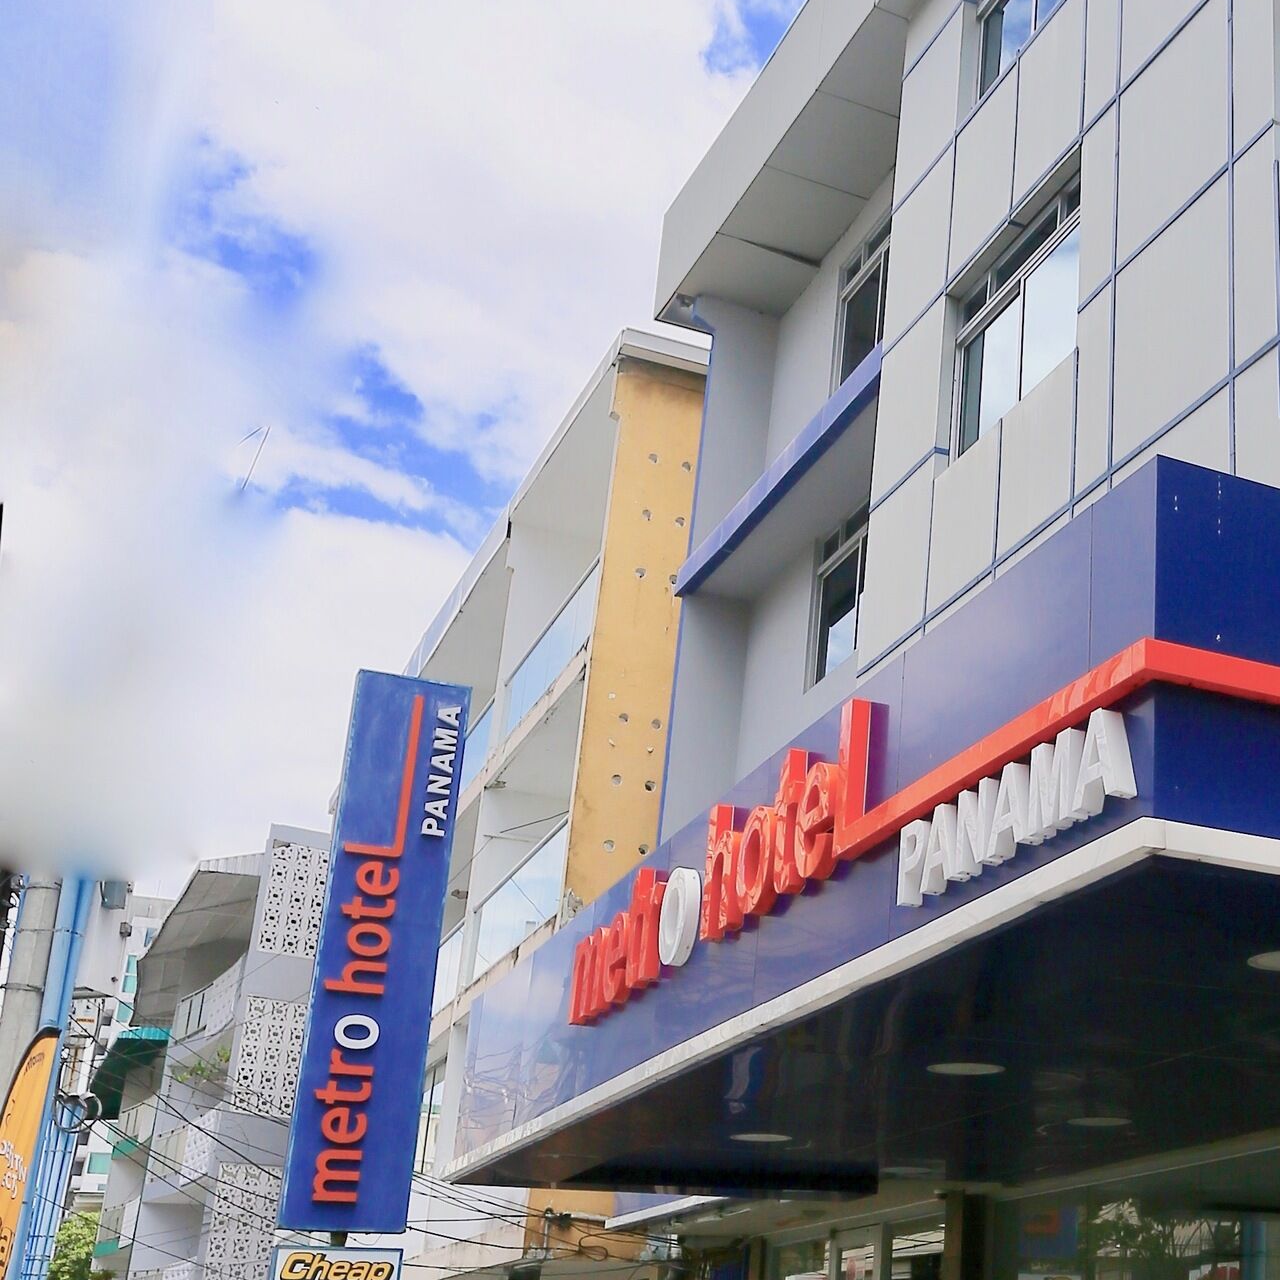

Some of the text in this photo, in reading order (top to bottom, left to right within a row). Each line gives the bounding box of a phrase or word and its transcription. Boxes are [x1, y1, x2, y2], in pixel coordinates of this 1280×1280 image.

[420, 705, 462, 838] PANAMA
[568, 697, 873, 1026] metro hotel
[897, 708, 1137, 907] PANAMA
[312, 1013, 381, 1205] metro
